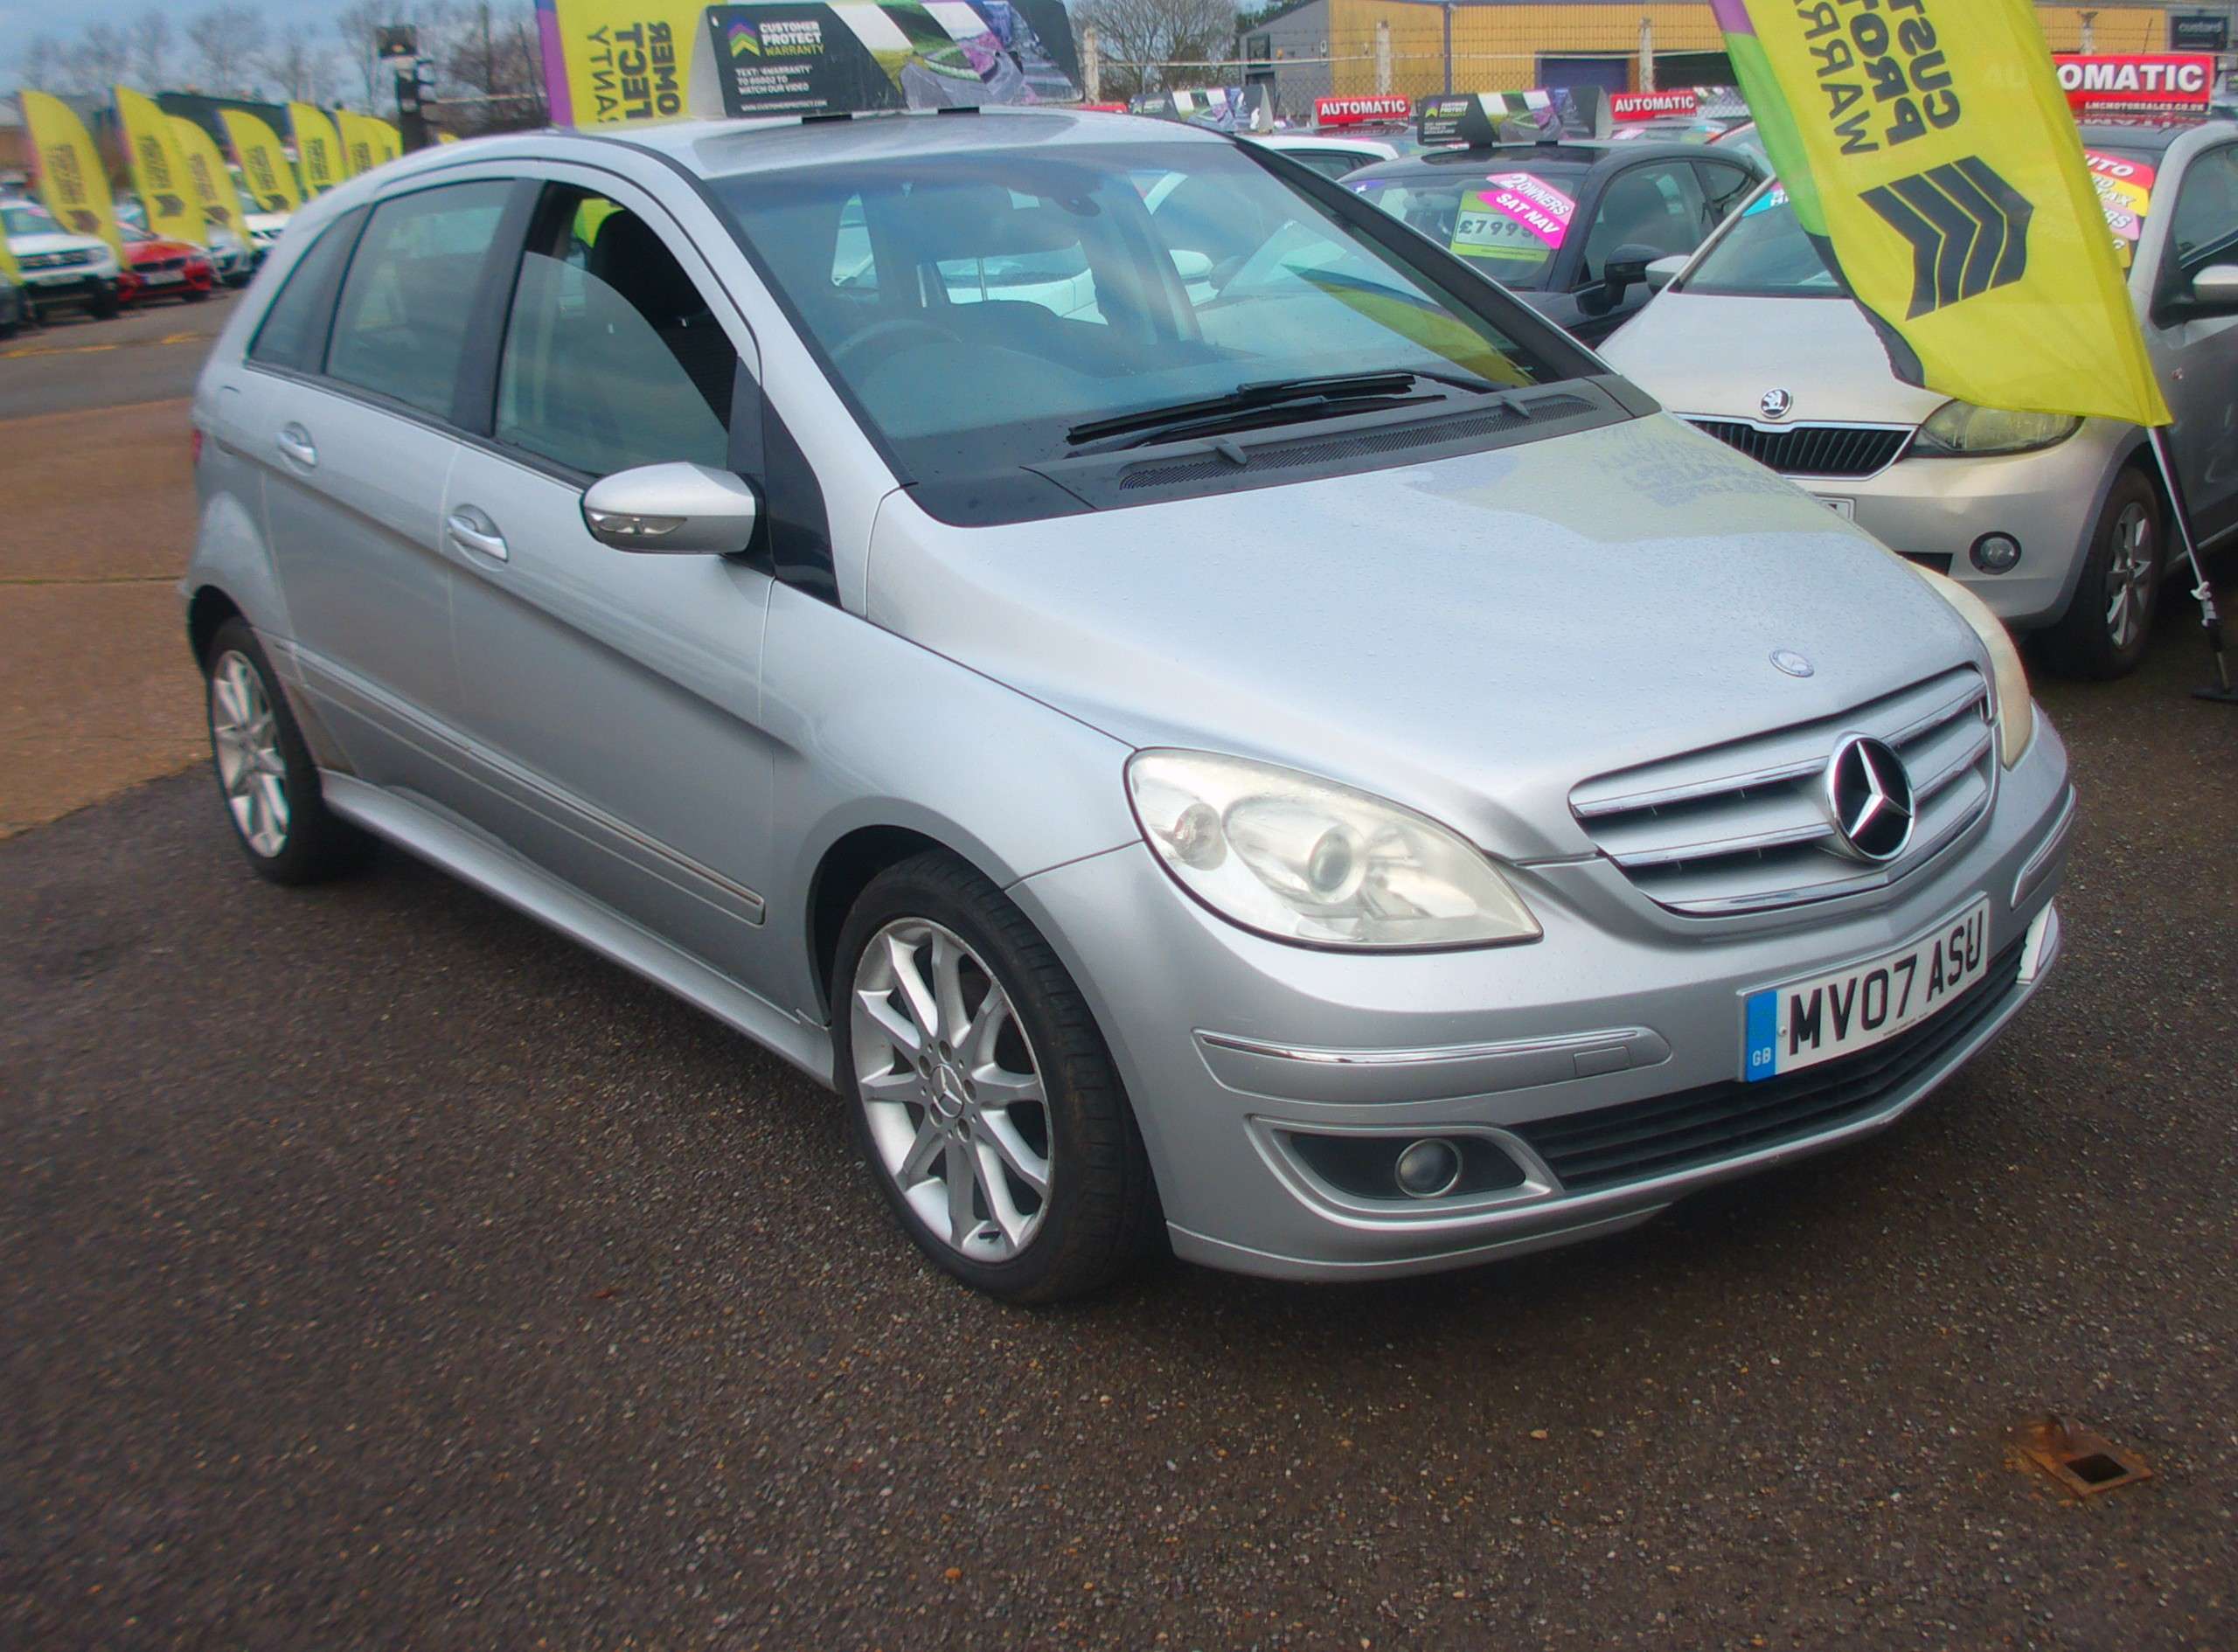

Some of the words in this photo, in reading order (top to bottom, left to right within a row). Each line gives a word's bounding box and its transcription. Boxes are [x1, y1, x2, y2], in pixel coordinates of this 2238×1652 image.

[759, 21, 820, 33] CUSTOMER
[761, 32, 822, 46] PROTECT
[765, 44, 824, 56] WARRANTY
[2056, 63, 2203, 91] OMATIC
[1321, 100, 1407, 115] AUTOMATIC
[1615, 96, 1694, 113] AUTOMATIC
[1518, 182, 1570, 216] OWNERS
[1496, 193, 1531, 212] SAT
[1524, 211, 1560, 233] NAV
[1790, 954, 1917, 1056] MV07
[1927, 910, 1983, 1003] ASU
[1752, 1047, 1771, 1066] GB
